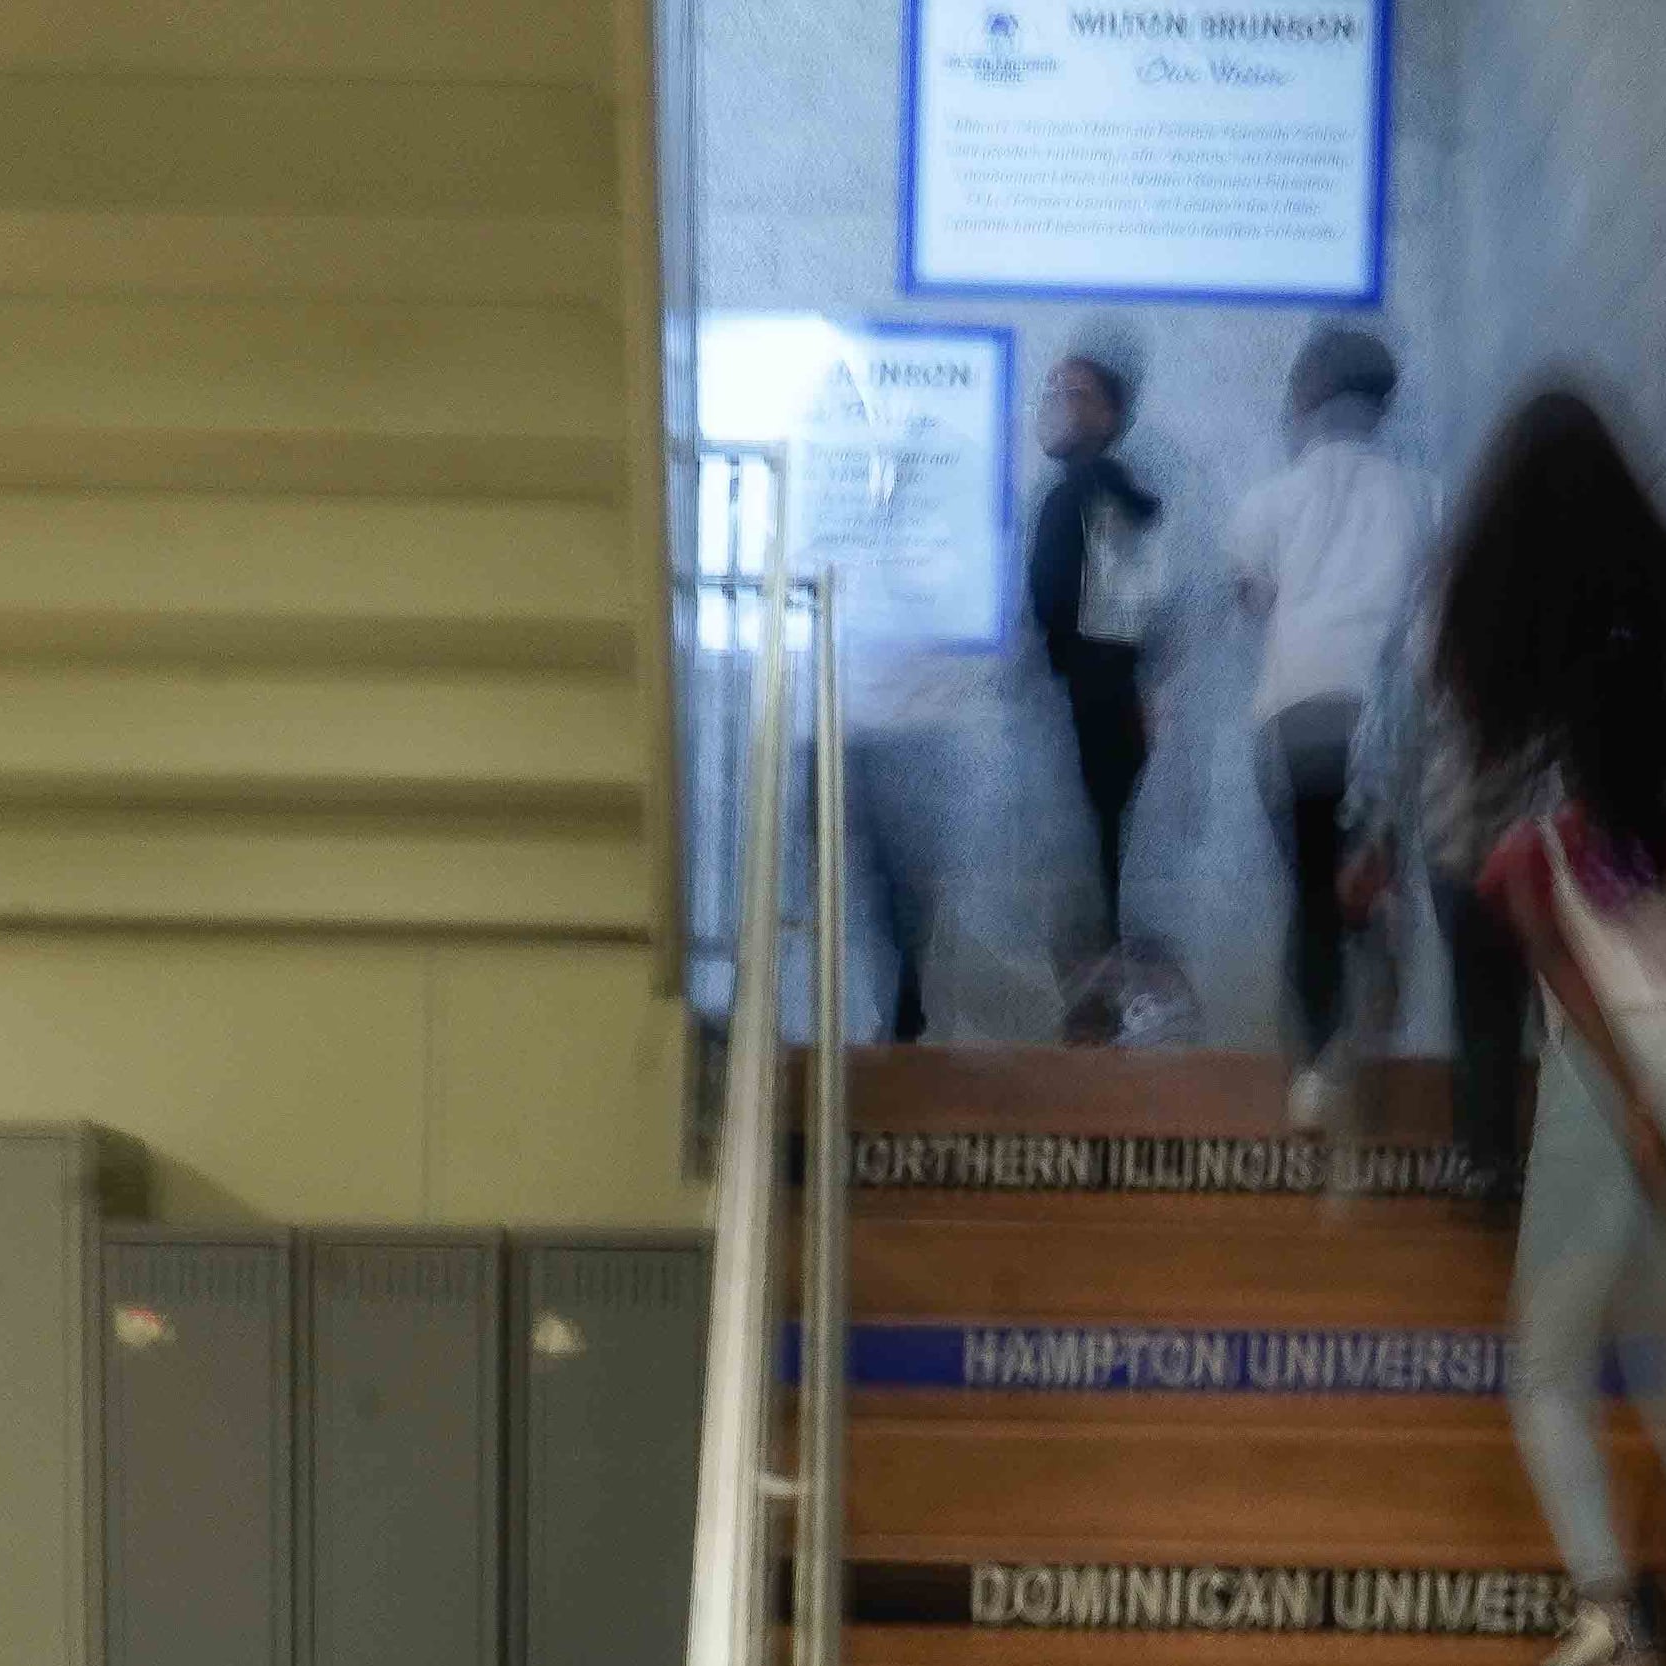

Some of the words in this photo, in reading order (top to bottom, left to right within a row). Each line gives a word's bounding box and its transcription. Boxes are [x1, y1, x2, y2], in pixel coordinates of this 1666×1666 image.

[845, 1131, 1090, 1187] ORTHERN
[962, 1328, 1227, 1386] HAMPTON
[969, 1564, 1309, 1630] DOMINICAN
